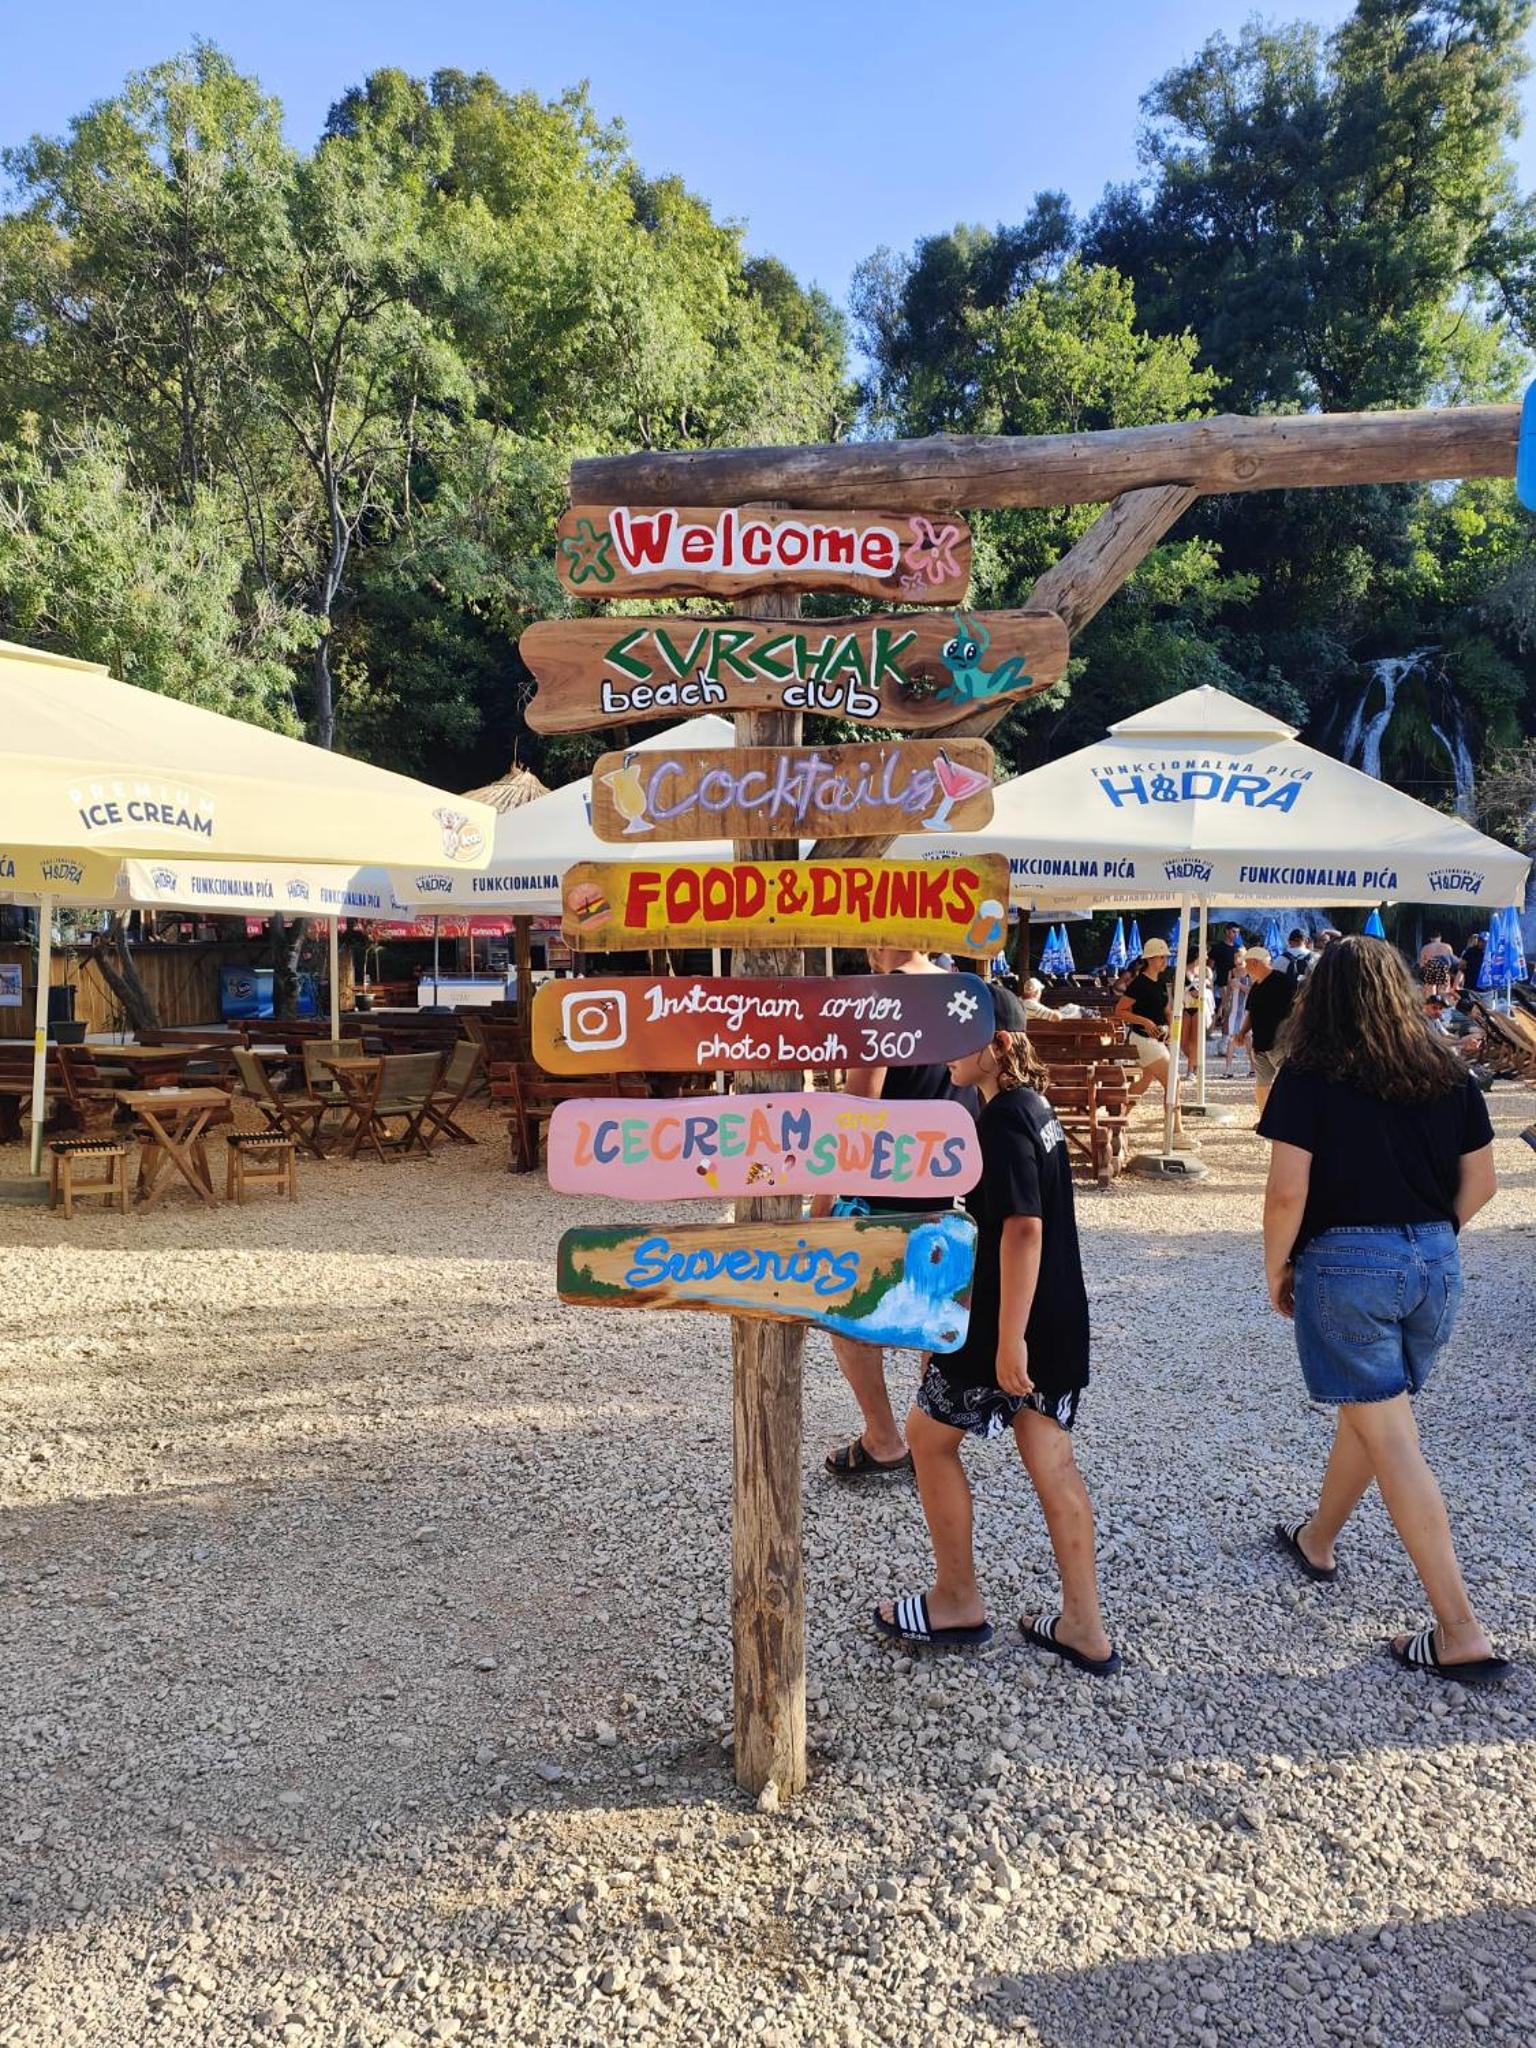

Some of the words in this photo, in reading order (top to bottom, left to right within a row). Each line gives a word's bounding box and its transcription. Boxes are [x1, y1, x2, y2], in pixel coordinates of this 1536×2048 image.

[610, 508, 896, 574] Welcome
[602, 627, 918, 690] CVRCHAK
[601, 667, 728, 714] beach
[782, 677, 881, 718] club
[647, 749, 939, 820] Cocktails
[1091, 759, 1254, 778] FUNKCIONALNA
[1265, 766, 1315, 782] PIĆA
[69, 779, 216, 815] PREMIUM
[79, 802, 123, 830] ICE
[127, 801, 214, 837] CREAM
[192, 876, 254, 897] FUNKCIONALNA
[256, 878, 274, 898] PIĆA
[472, 875, 559, 893] FUNKCIONALNA
[1103, 857, 1136, 879] PIĆA
[1239, 865, 1357, 887] FUNKCIONALNA
[1362, 867, 1398, 889] PIĆA
[623, 865, 767, 928] FOOD
[776, 868, 808, 915] &
[809, 866, 980, 925] DRINKS
[643, 984, 804, 1031] Instagram
[696, 1033, 771, 1066] photo
[777, 1033, 848, 1062] booth
[860, 1028, 923, 1062] 360°
[572, 1107, 812, 1169] ICECREAM
[805, 1130, 966, 1183] SWEETS
[623, 1237, 861, 1297] Suvenirs
